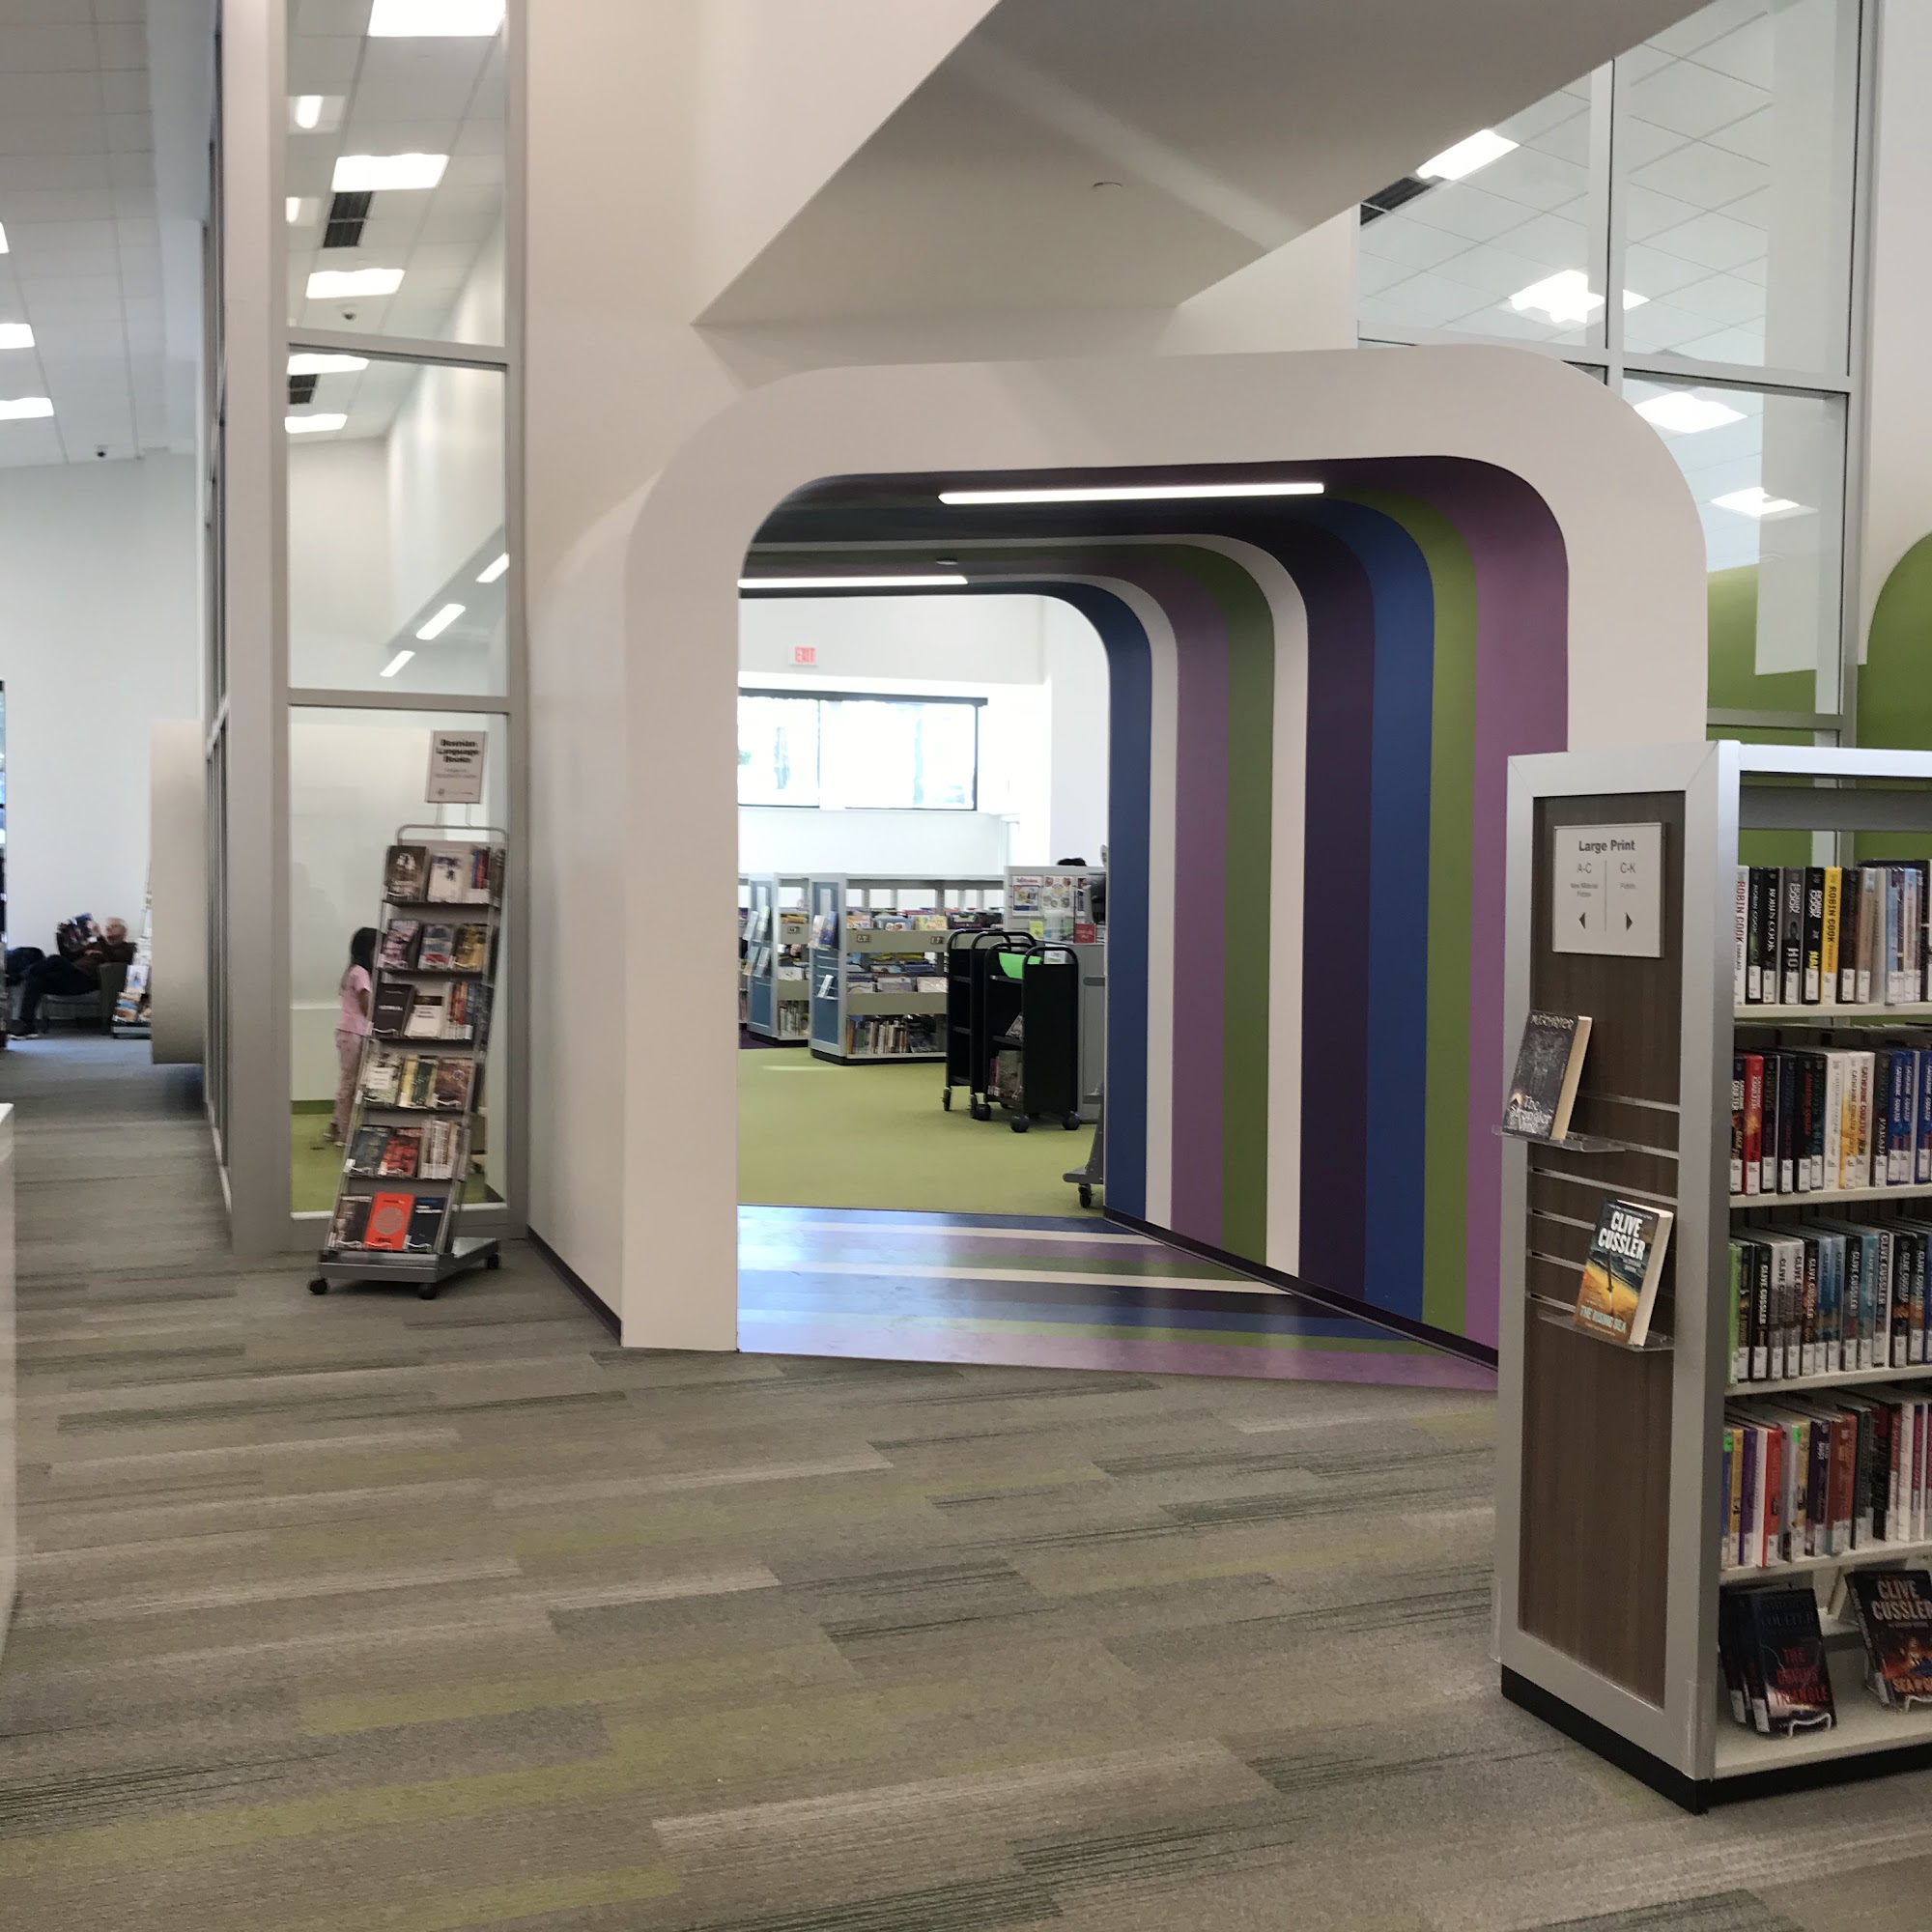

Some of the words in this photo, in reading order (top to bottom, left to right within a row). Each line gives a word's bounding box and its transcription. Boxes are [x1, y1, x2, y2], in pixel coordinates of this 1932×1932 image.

[1578, 840, 1607, 854] Large
[1610, 839, 1635, 852] Print
[1577, 863, 1592, 874] A-C
[1620, 862, 1636, 874] C-K
[1736, 881, 1746, 913] ROBIN
[1735, 916, 1745, 943] COOK
[1767, 920, 1776, 952] COOK
[1827, 919, 1835, 943] COOK
[1786, 948, 1799, 971] HO
[1610, 1210, 1643, 1238] CLIVE
[1598, 1228, 1645, 1261] CUSSLER
[1880, 1235, 1889, 1261] CLIVE
[1851, 1251, 1860, 1273] CLIVE
[1902, 1252, 1911, 1271] CLIVE
[1850, 1275, 1859, 1310] CUSSLER
[1878, 1263, 1888, 1305] CUSSLER
[1901, 1273, 1910, 1303] CUSSLER
[1916, 1275, 1924, 1311] CUSSLER
[1806, 1283, 1815, 1320] CUSSLER
[1877, 1579, 1919, 1600] CLIVE
[1871, 1600, 1932, 1621] CUSSLER
